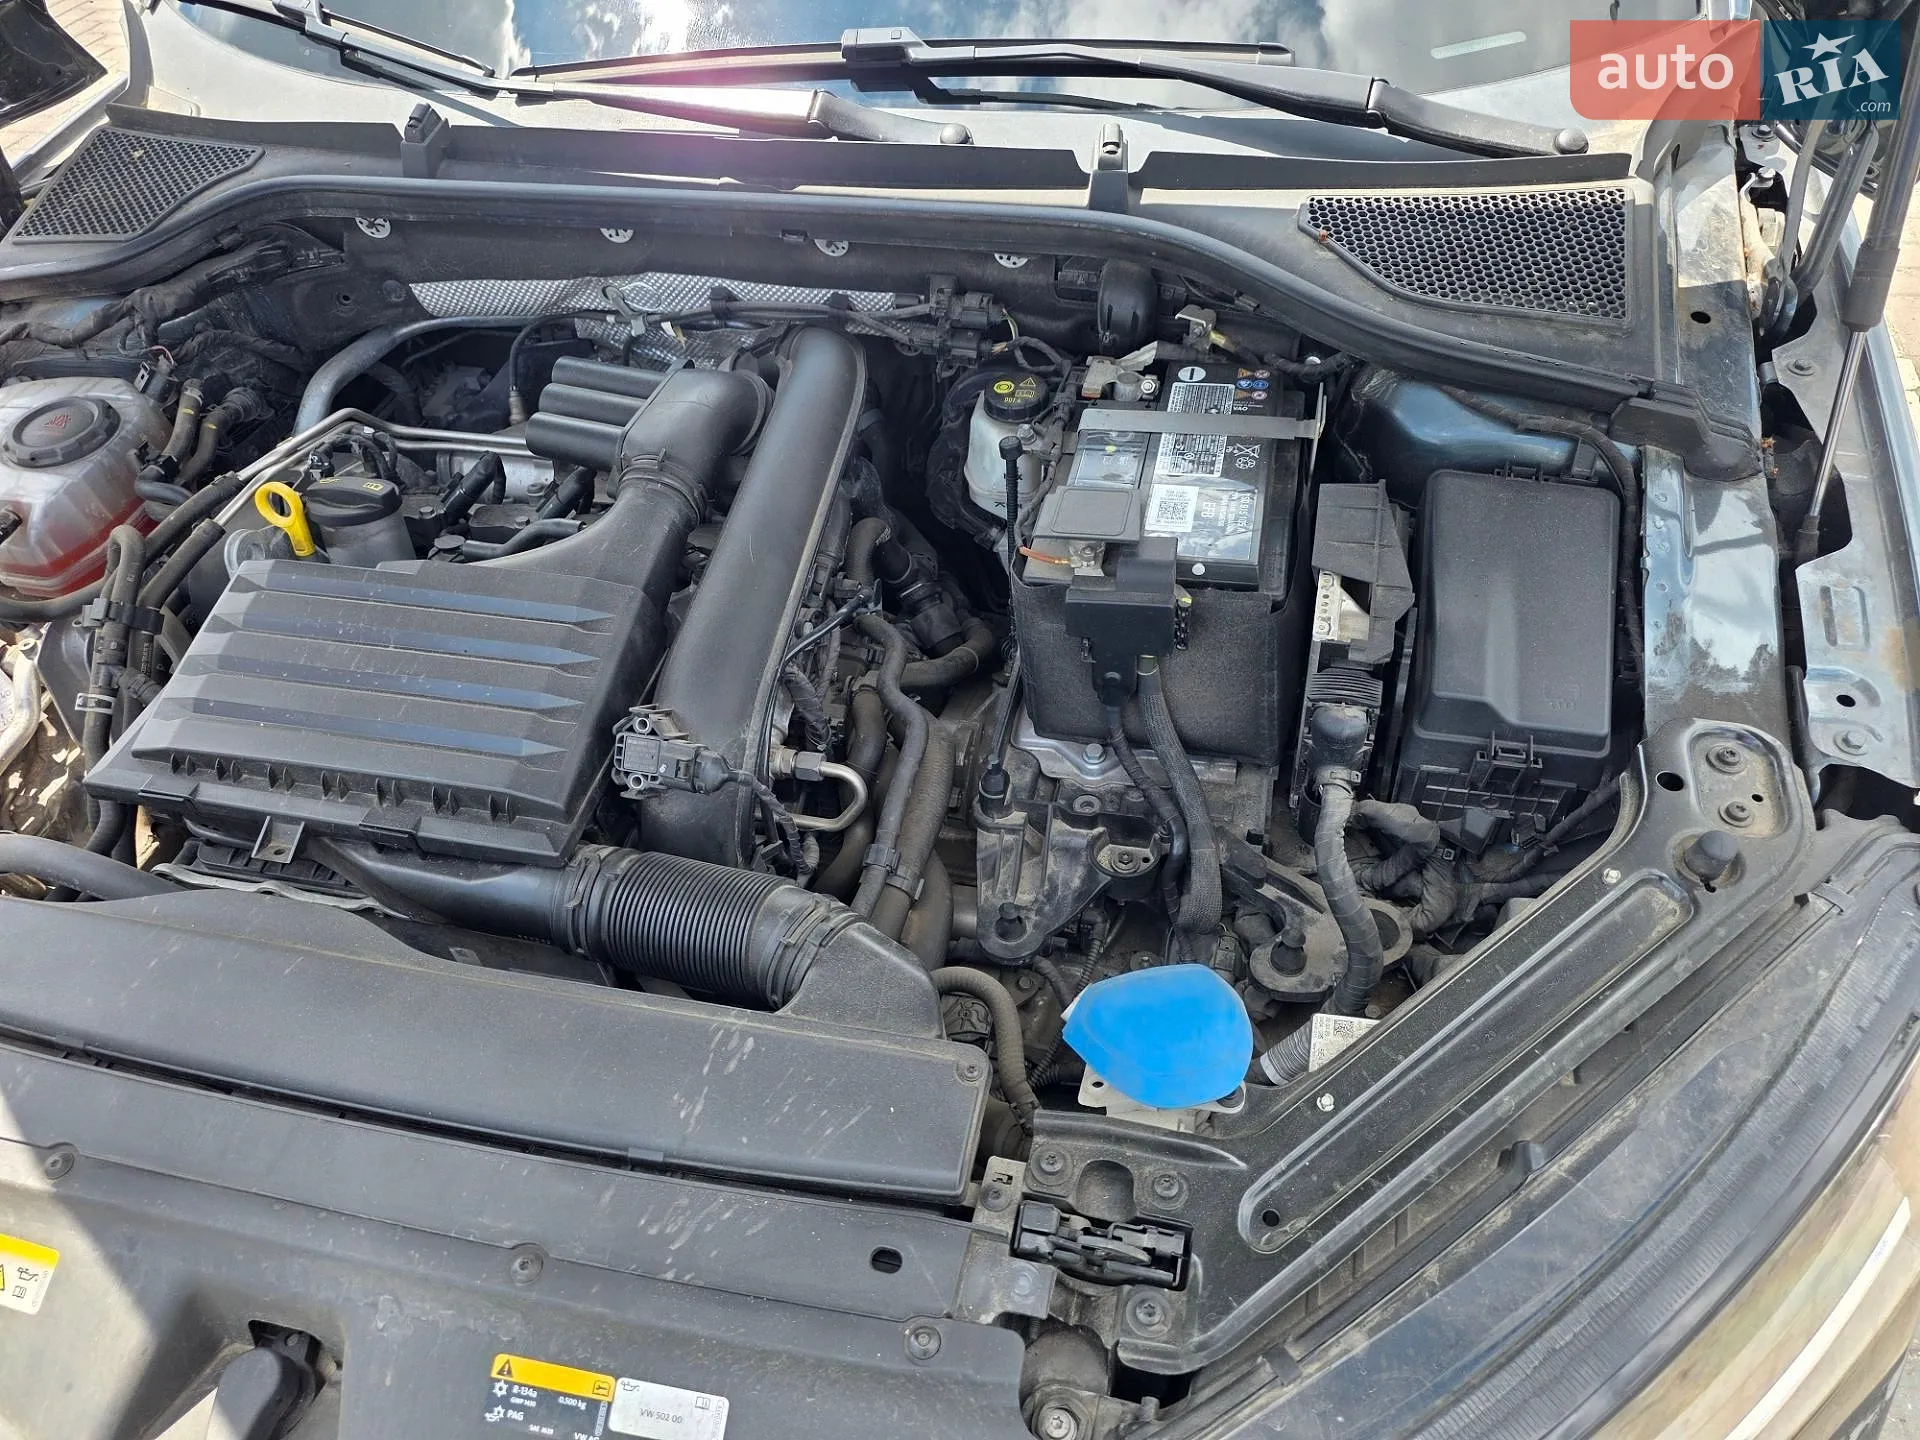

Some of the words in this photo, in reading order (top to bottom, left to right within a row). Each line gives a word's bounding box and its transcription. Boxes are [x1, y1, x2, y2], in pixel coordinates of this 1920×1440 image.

[506, 1409, 525, 1421] PAG
[639, 1407, 655, 1418] VW
[655, 1411, 671, 1423] 502
[670, 1414, 684, 1424] 00
